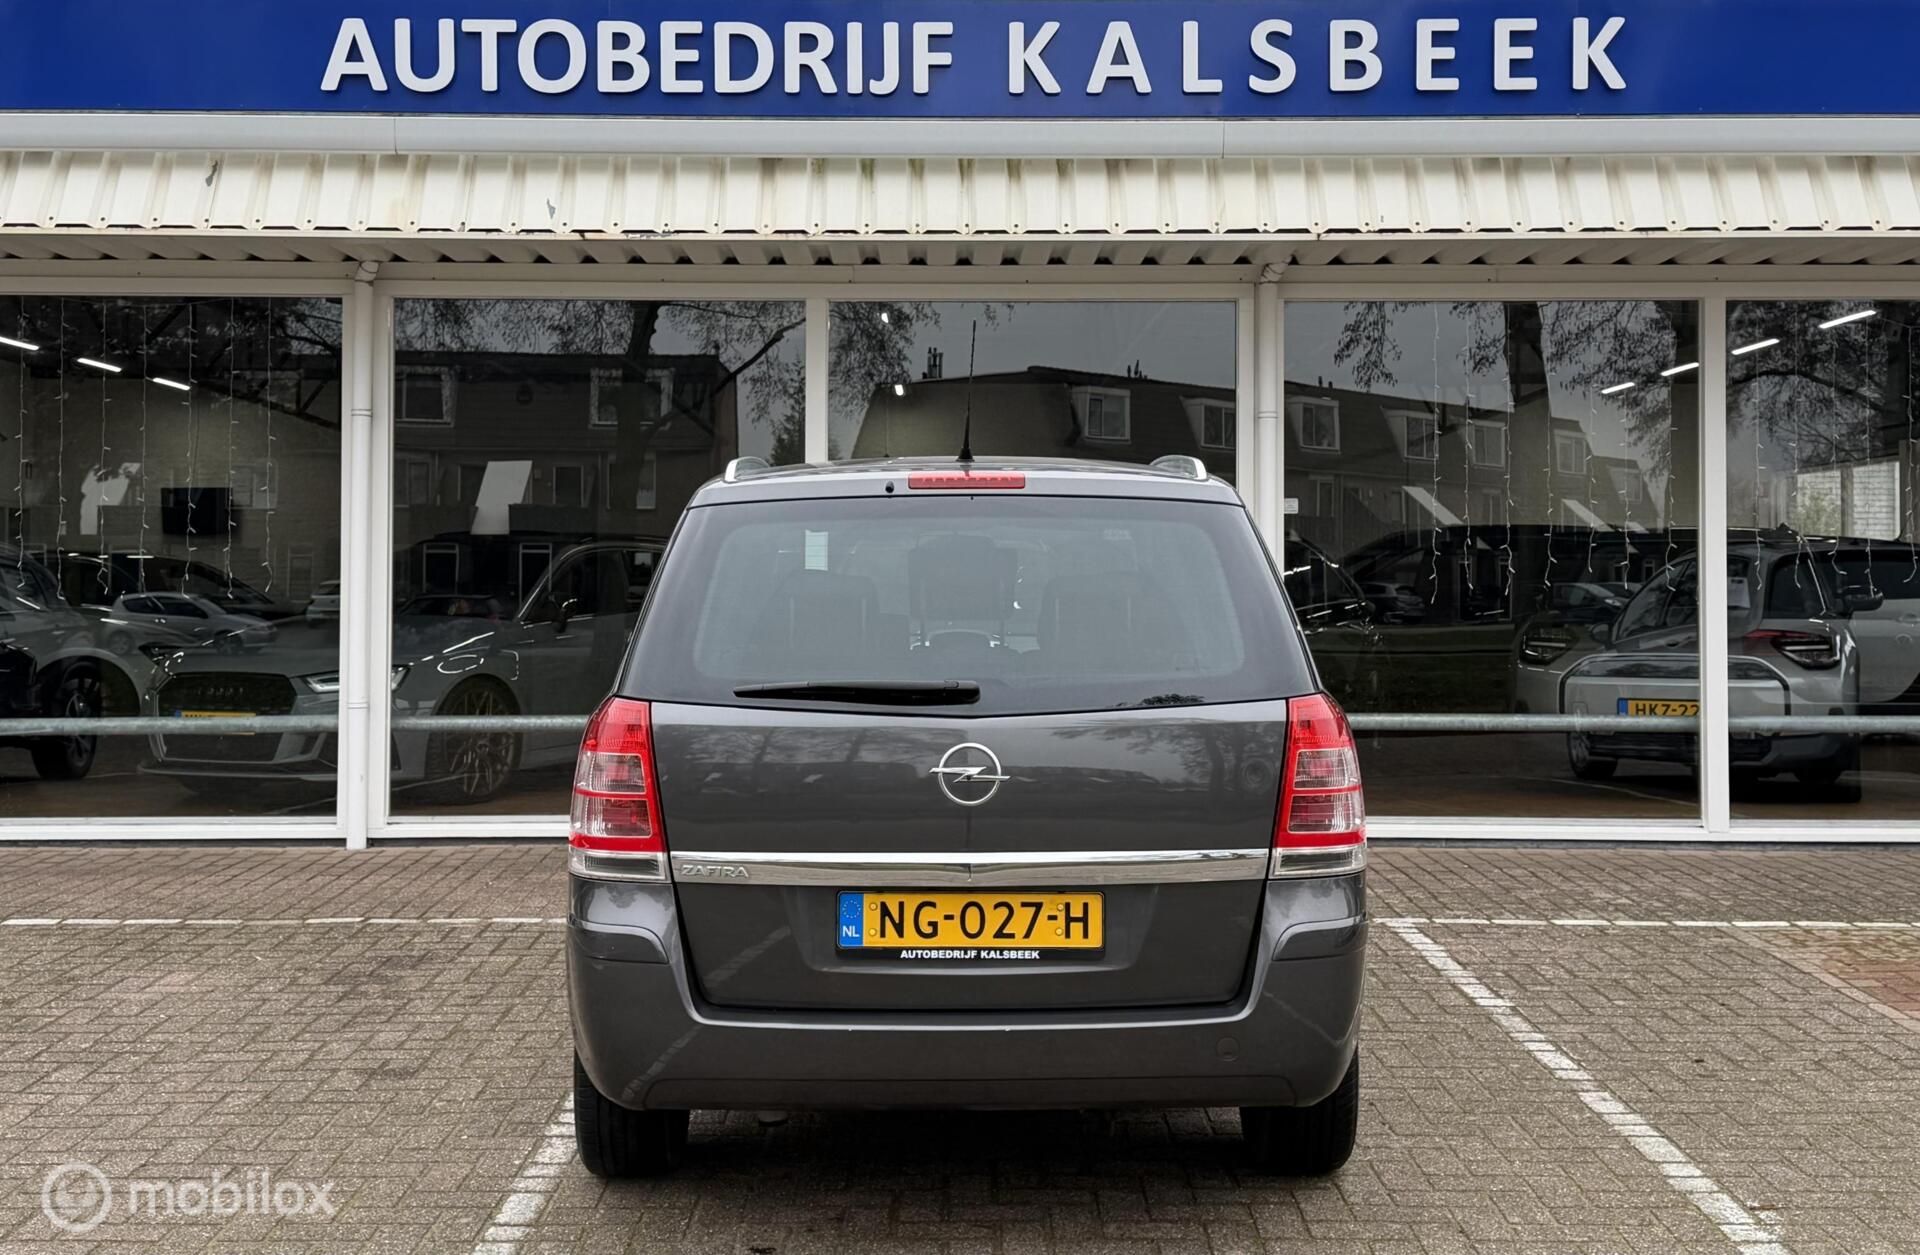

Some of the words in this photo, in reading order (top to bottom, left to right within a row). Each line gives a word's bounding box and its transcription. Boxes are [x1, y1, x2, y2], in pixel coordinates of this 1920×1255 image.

[321, 17, 954, 94] AUTOBEDRIJF
[1007, 17, 1627, 95] KALSBEEK
[681, 864, 749, 879] ZAFIRA
[879, 900, 1089, 940] NG-027-H
[842, 926, 860, 938] NL
[900, 950, 978, 959] AUTOBEDRIJF
[980, 950, 1040, 959] KALSBEEK
